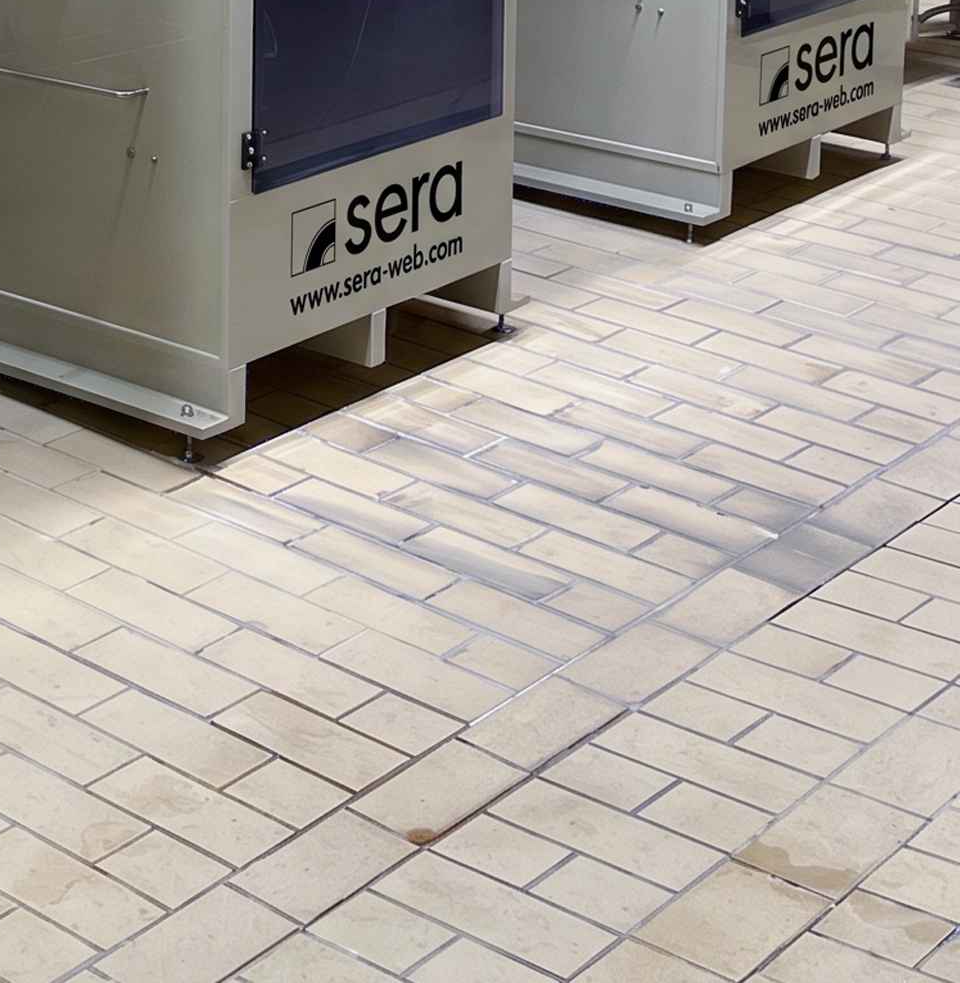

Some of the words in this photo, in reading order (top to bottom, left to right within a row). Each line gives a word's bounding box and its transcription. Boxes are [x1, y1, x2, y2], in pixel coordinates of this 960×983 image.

[795, 21, 874, 92] sera
[758, 81, 874, 137] www.sera-web.com
[344, 160, 463, 255] sera
[289, 236, 463, 316] www.sera-web.com
